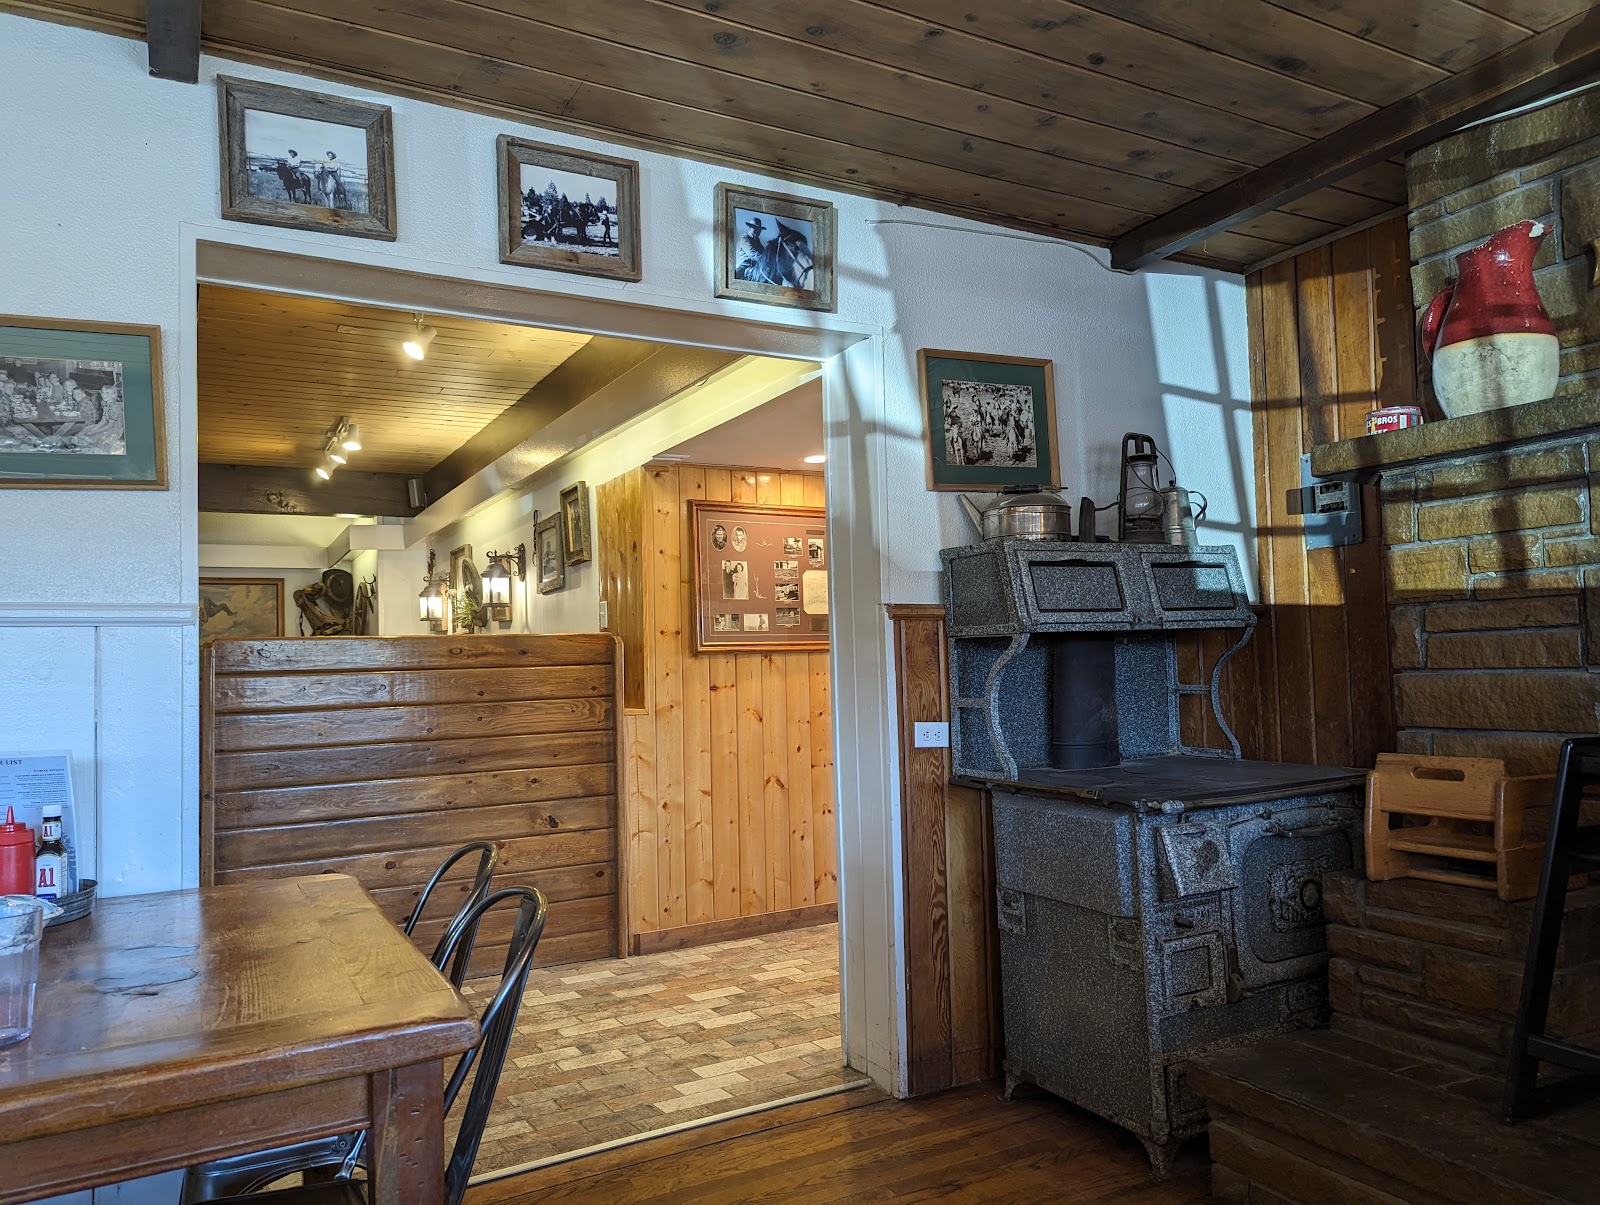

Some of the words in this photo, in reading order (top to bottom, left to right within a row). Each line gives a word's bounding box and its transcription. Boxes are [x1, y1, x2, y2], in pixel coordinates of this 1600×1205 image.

[1377, 416, 1398, 425] BROS
[43, 825, 53, 838] A1
[38, 867, 56, 887] A1
